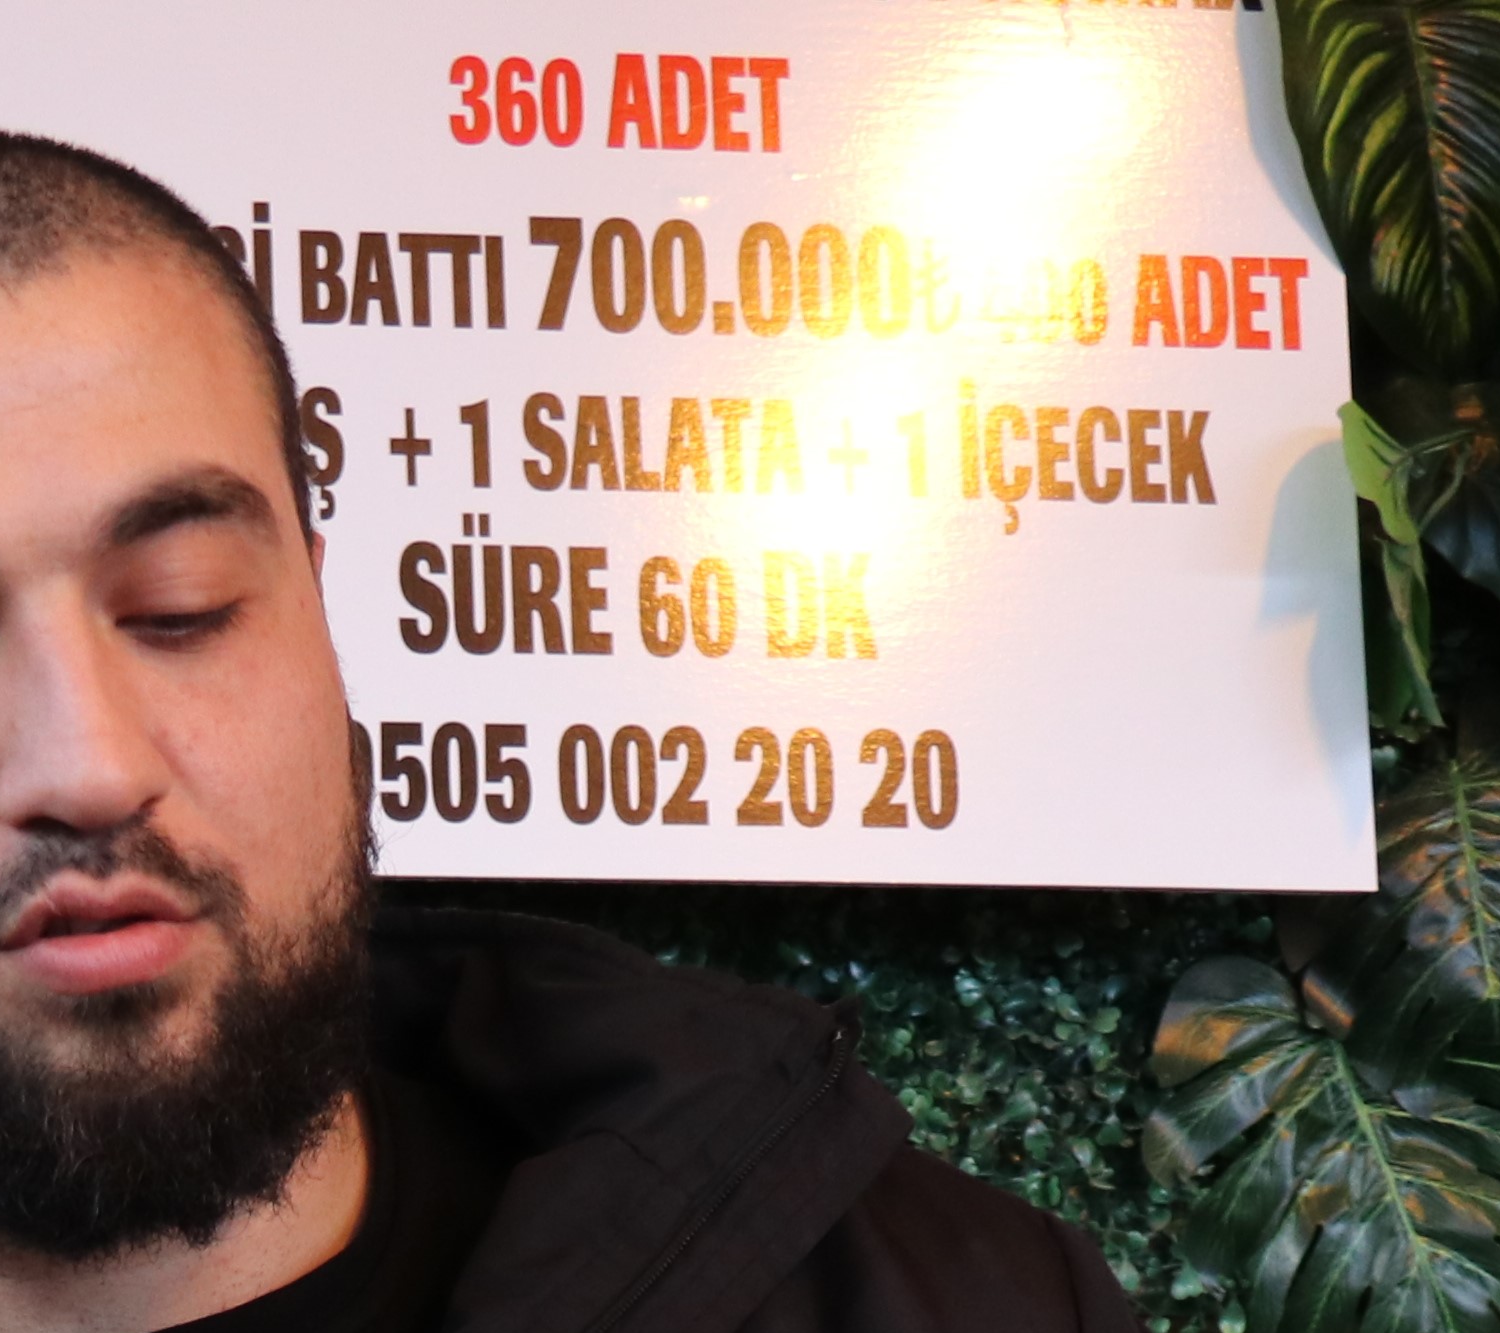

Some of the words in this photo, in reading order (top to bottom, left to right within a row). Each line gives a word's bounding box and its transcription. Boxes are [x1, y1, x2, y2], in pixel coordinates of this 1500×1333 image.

[449, 55, 583, 147] 360
[607, 53, 789, 152] ADET
[299, 229, 507, 330] BATTI
[1131, 254, 1309, 351] ADET
[389, 407, 432, 487] +
[459, 398, 492, 489] 1
[522, 391, 807, 494] SALATA
[895, 410, 930, 499] 1
[960, 377, 1217, 535] İÇECEK
[398, 512, 614, 656] SÜRE
[638, 555, 737, 659] 60
[763, 548, 880, 662] DK
[558, 723, 708, 827] 002
[734, 726, 834, 829] 20
[859, 728, 960, 831] 20
